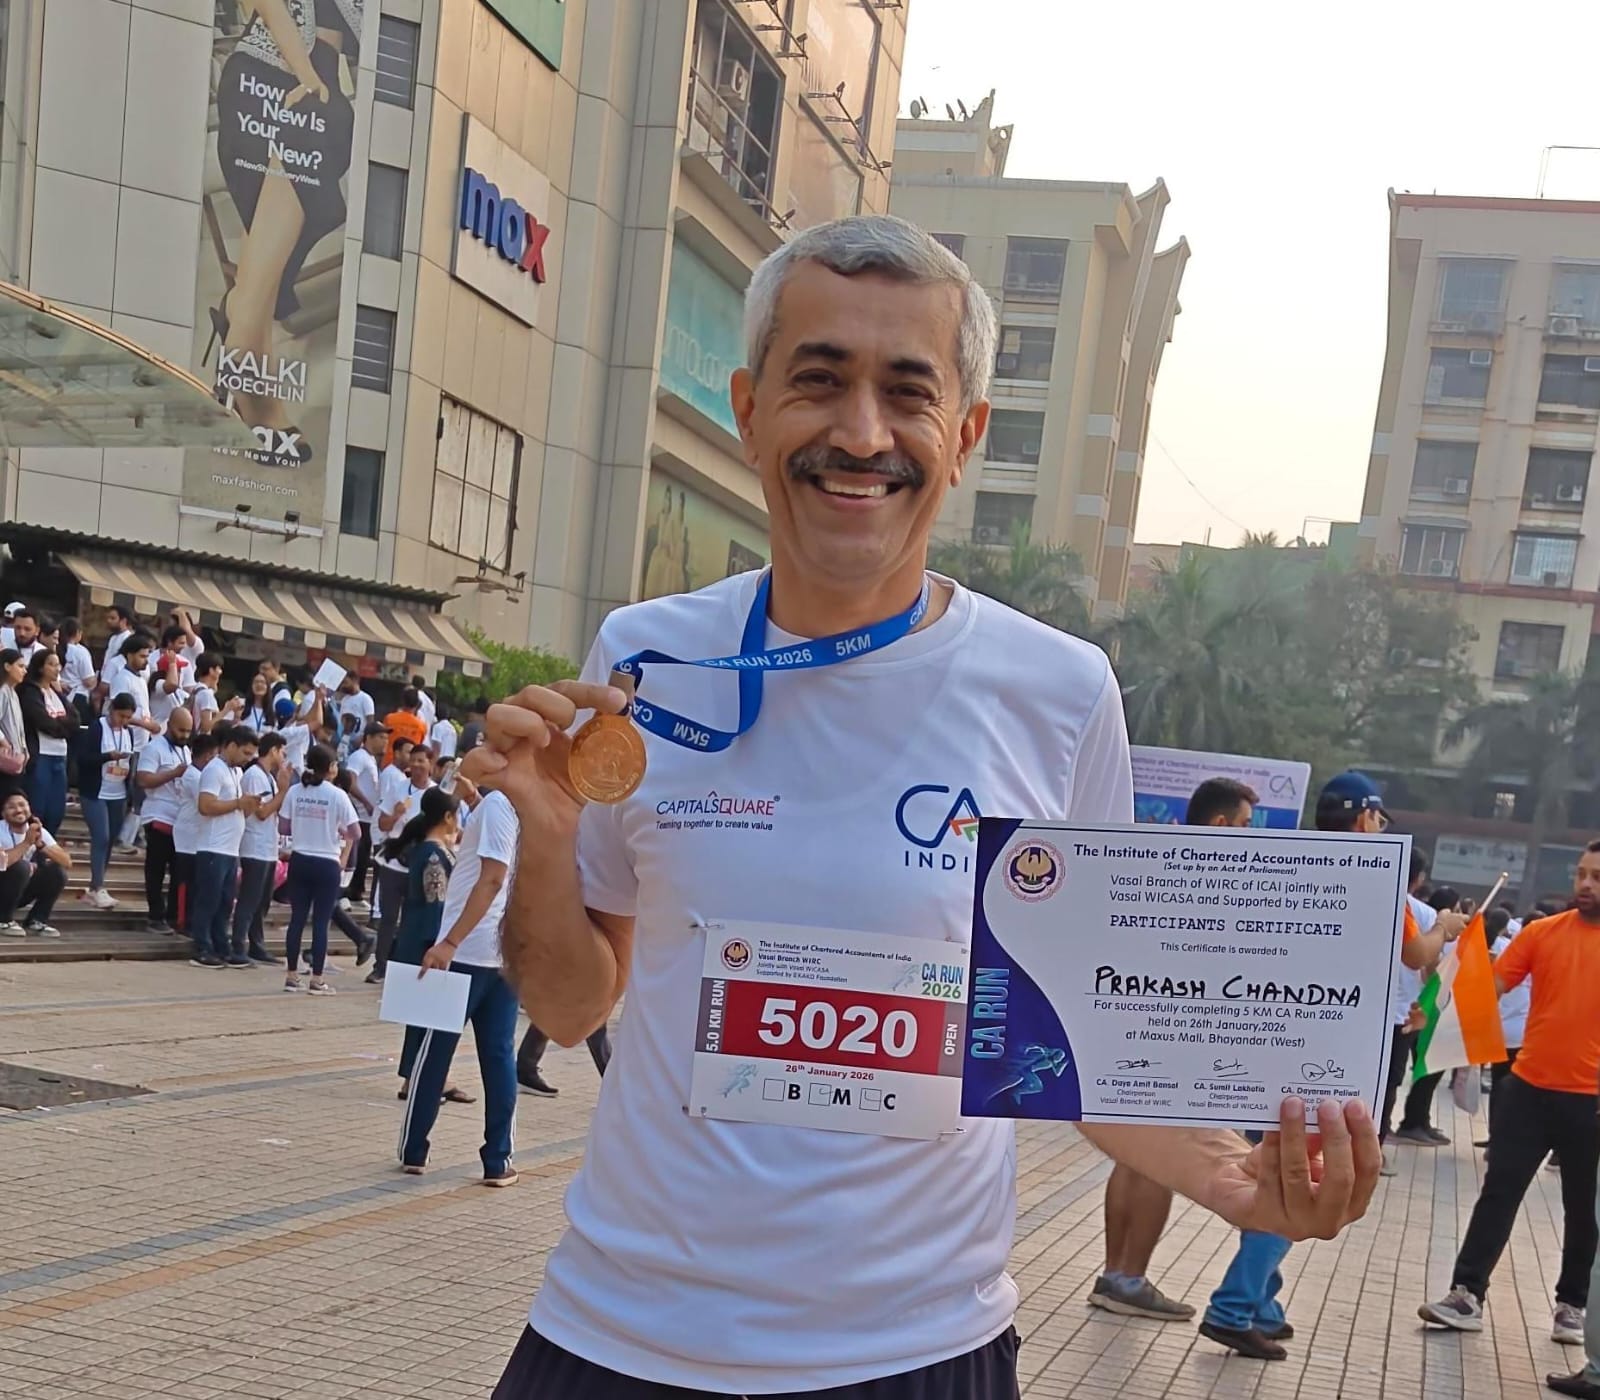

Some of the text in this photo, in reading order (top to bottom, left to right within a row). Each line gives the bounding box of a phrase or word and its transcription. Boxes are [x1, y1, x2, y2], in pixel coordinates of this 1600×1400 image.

[240, 73, 285, 102] How
[237, 111, 280, 139] Your
[262, 99, 326, 132] New Is
[268, 140, 322, 170] New?
[460, 167, 550, 284] max
[218, 345, 307, 387] KALKI
[217, 373, 304, 403] KOECHLIN
[251, 425, 302, 457] ax
[211, 474, 299, 497] maxfashion.com
[704, 633, 872, 668] CA RUN 2026 5KM
[672, 721, 711, 747] 5KM
[684, 819, 713, 830] together
[716, 819, 723, 828] to
[725, 820, 749, 829] create
[752, 821, 773, 831] value
[896, 784, 982, 848] CA
[905, 850, 968, 873] INDI
[1074, 843, 1391, 869] The Institute of Chartered Accountants of India
[1164, 861, 1181, 871] (Set
[1183, 863, 1194, 873] up
[1196, 862, 1206, 873] by
[1221, 864, 1235, 873] Act
[1238, 864, 1247, 873] of
[1249, 865, 1298, 877] Parliament)
[1110, 874, 1347, 896] Vasai Branch of WIRC of ICAI jointly with
[1109, 890, 1348, 911] Vasai WICASA and Supported by EKAKO
[1110, 914, 1342, 936] PARTICIPANTS CERTIFICATE
[759, 940, 771, 948] The
[810, 945, 843, 955] Chartered
[1160, 941, 1289, 957] This Certificate is awarded to
[802, 957, 821, 965] WIRC
[921, 962, 964, 985] CA RUN
[921, 982, 962, 999] 2026
[1095, 965, 1361, 1008] PRAKASH CHANDNA
[706, 980, 725, 1052] 5.0 KM RUN
[971, 968, 1010, 1058] CA RUN
[1094, 999, 1344, 1021] For successfully completing 5 KM CA Run 2026
[758, 997, 918, 1058] 5020
[1148, 1016, 1287, 1033] held on 26th January,2026
[944, 1023, 958, 1056] OPEN
[1125, 1030, 1306, 1049] at Maxus Mall, Bhayandar (West)
[785, 1063, 874, 1081] 26th January 2026
[787, 1083, 897, 1110] B M C
[1194, 1082, 1208, 1091] CA.
[1281, 1086, 1294, 1095] CA.
